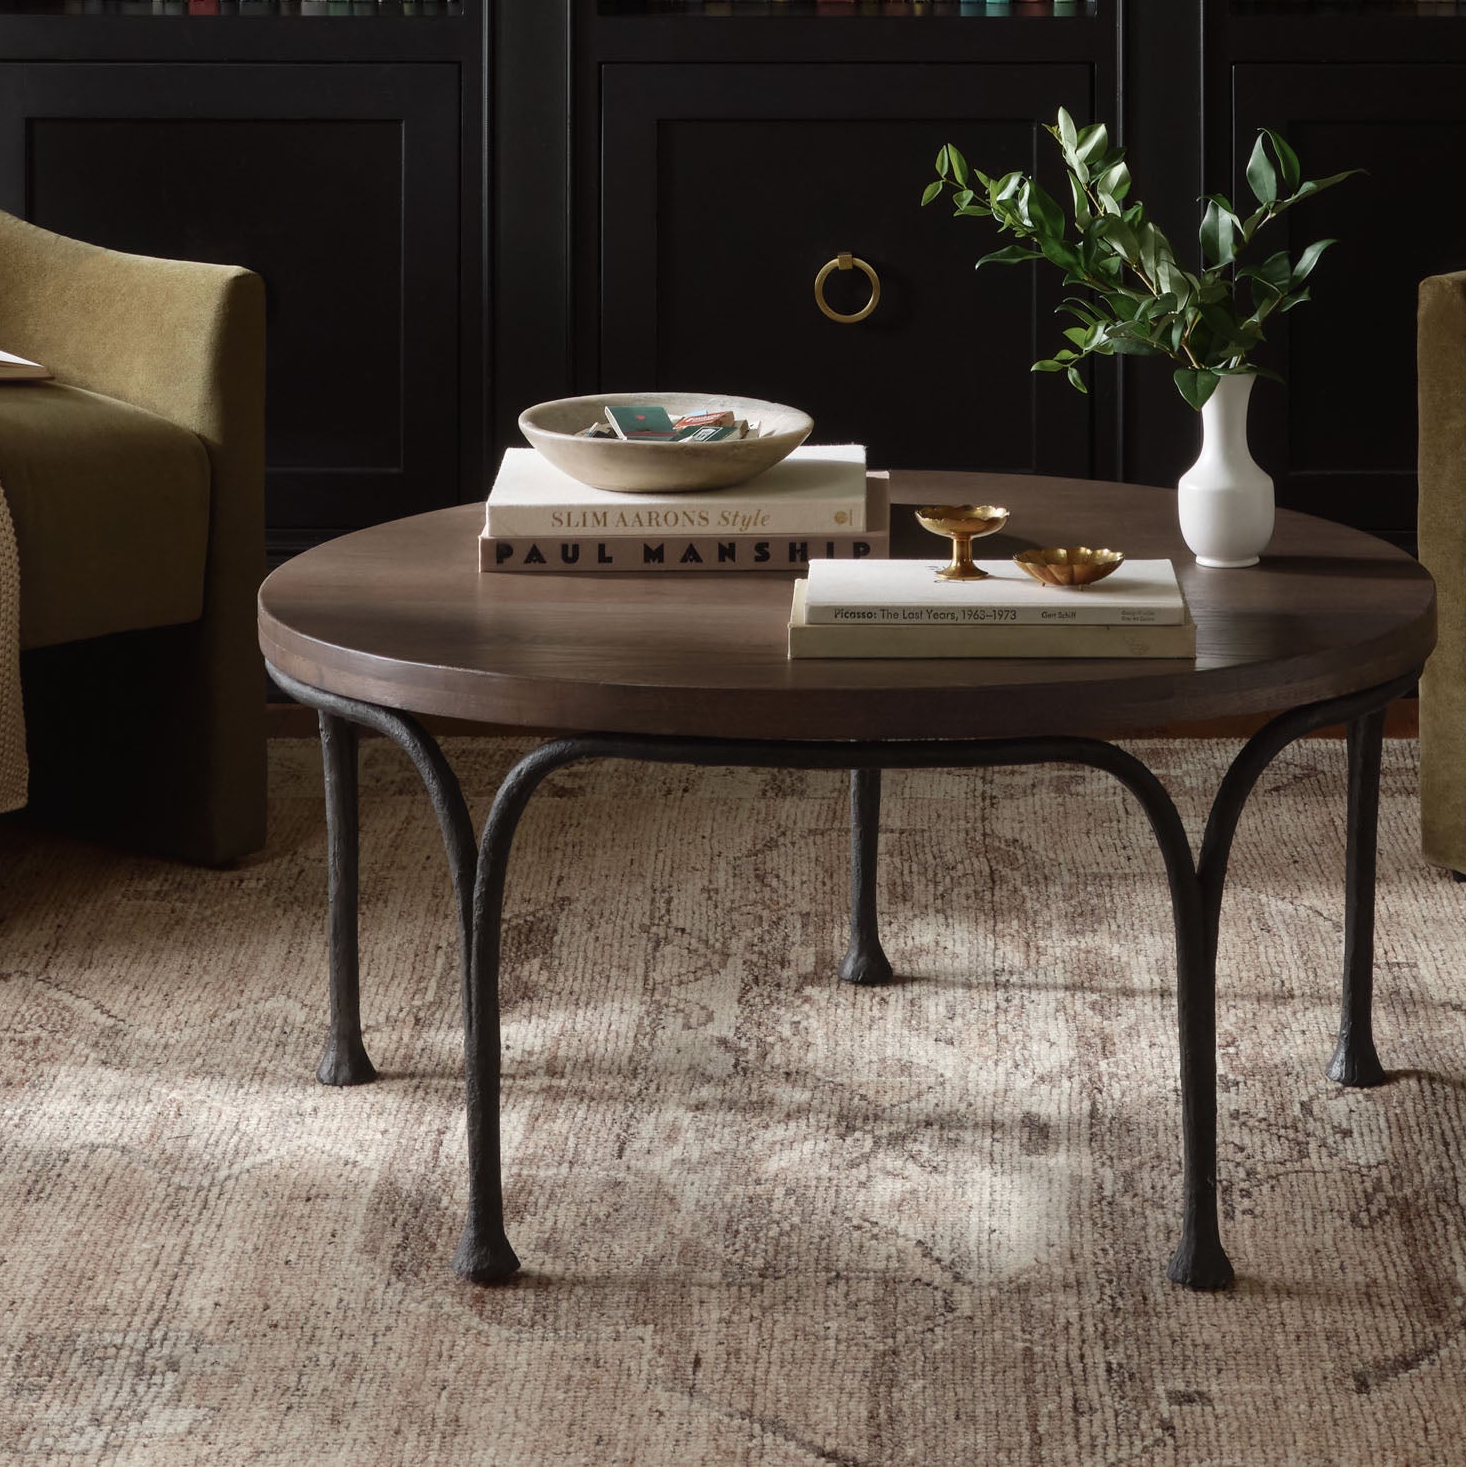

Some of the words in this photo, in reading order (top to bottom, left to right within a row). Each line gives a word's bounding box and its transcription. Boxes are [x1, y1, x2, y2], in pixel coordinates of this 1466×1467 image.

[552, 510, 609, 527] SLIM
[616, 510, 710, 527] AARONS
[717, 509, 771, 531] Style
[496, 543, 613, 565] PAUL
[644, 542, 871, 563] MANSHIP
[834, 609, 877, 621] Picasso:
[880, 609, 900, 621] The
[903, 609, 925, 621] Last
[927, 609, 958, 623] Years,
